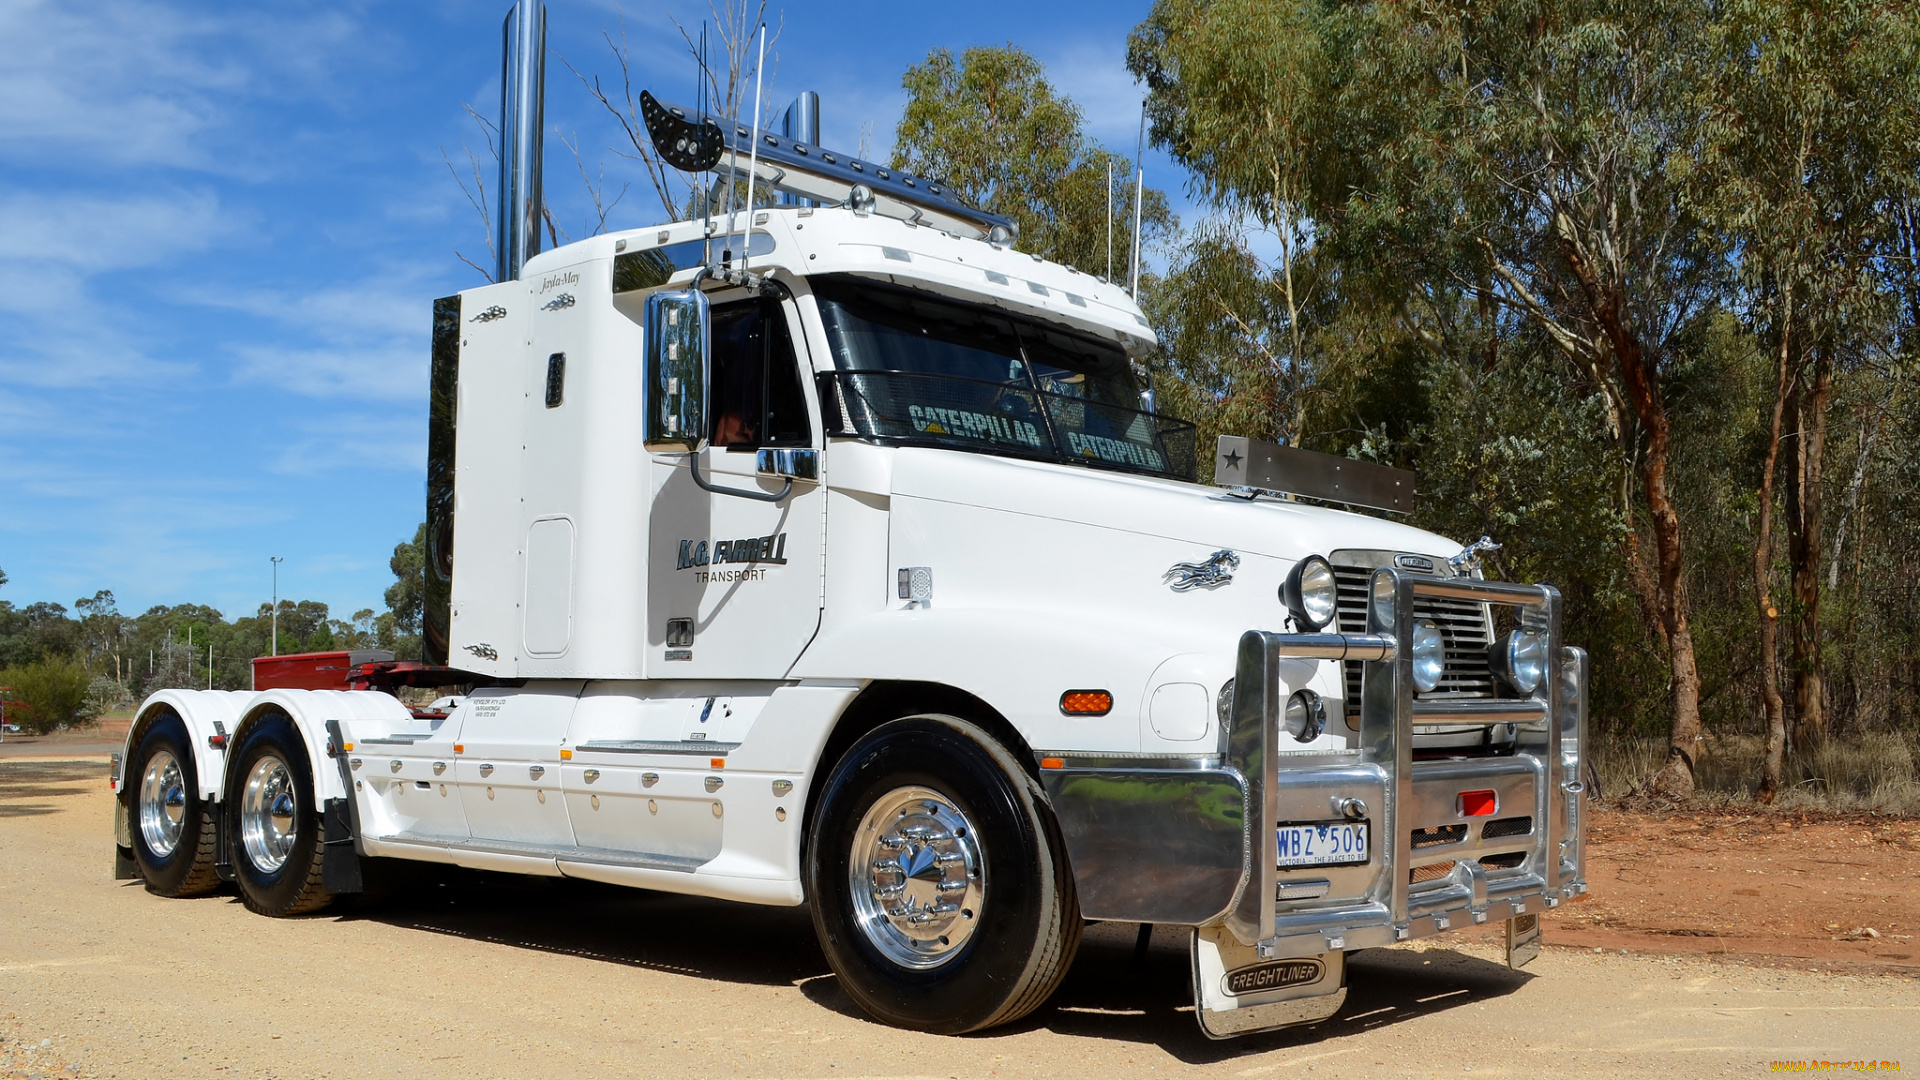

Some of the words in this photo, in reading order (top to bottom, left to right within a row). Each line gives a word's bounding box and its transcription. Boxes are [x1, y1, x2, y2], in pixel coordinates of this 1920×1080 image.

[908, 404, 1041, 446] CATERPILLAR
[1067, 431, 1166, 472] CATERPILLAR
[676, 540, 710, 570] K.G.
[712, 533, 787, 565] FARRELL
[695, 569, 766, 583] TRANSPORT
[1277, 829, 1314, 858] WBZ
[1331, 826, 1364, 853] 506
[1279, 858, 1306, 866] VICTORIA
[1232, 965, 1315, 989] FREIGHTLINER
